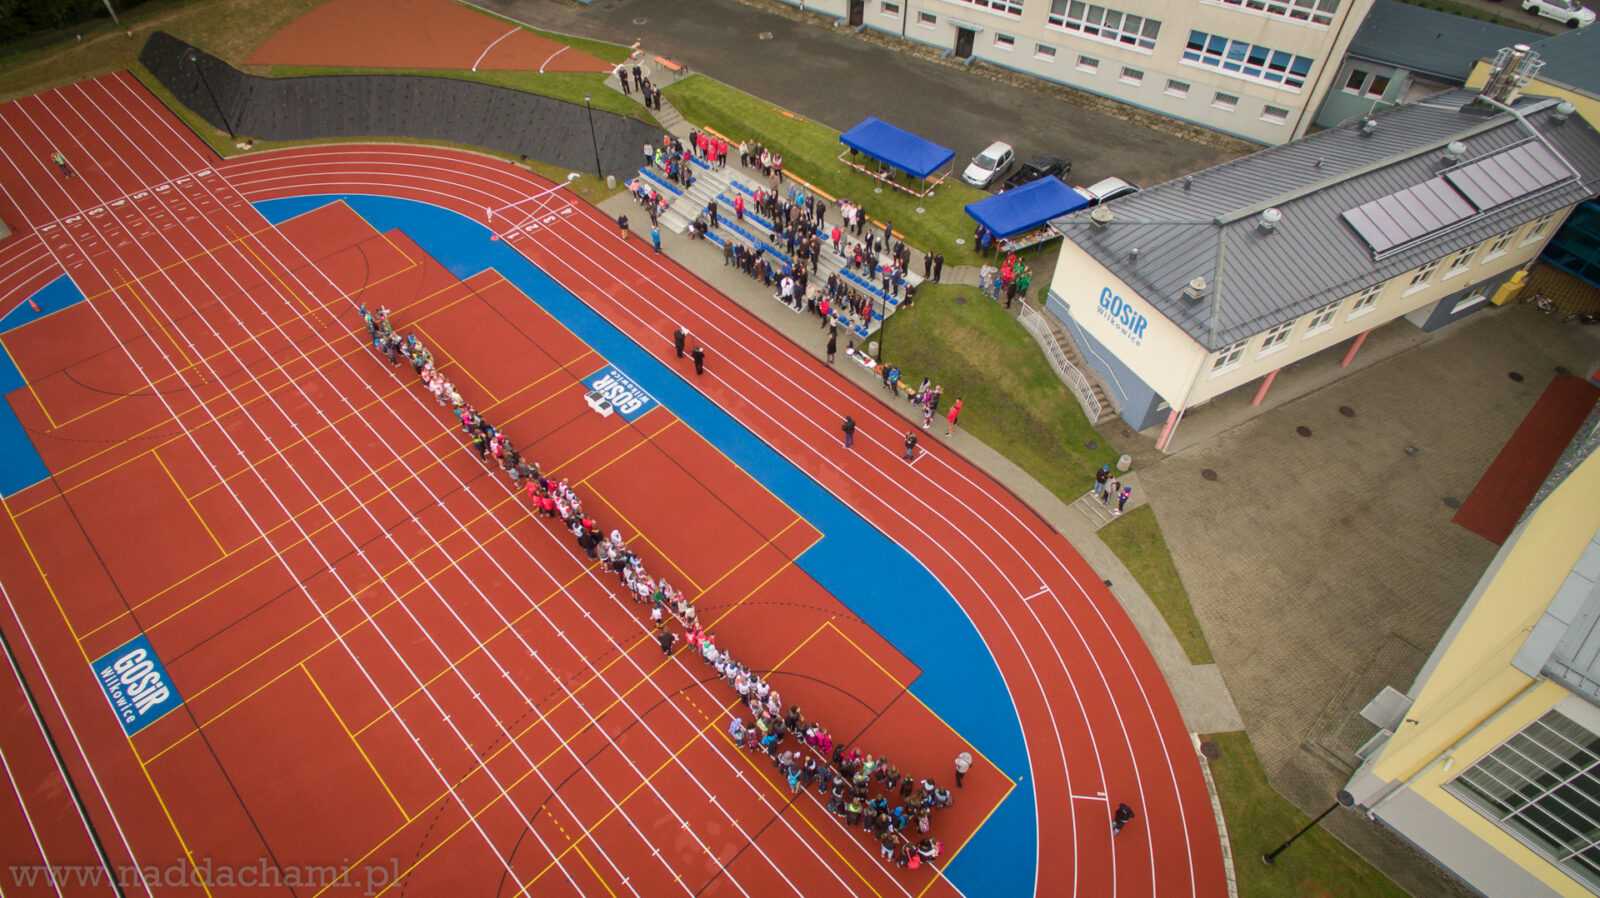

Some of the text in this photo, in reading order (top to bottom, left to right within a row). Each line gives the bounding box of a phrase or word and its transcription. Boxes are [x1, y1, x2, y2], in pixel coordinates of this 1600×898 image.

[1100, 287, 1148, 338] GOSiR
[100, 665, 136, 724] Wilkowice
[113, 648, 170, 716] GOSiR
